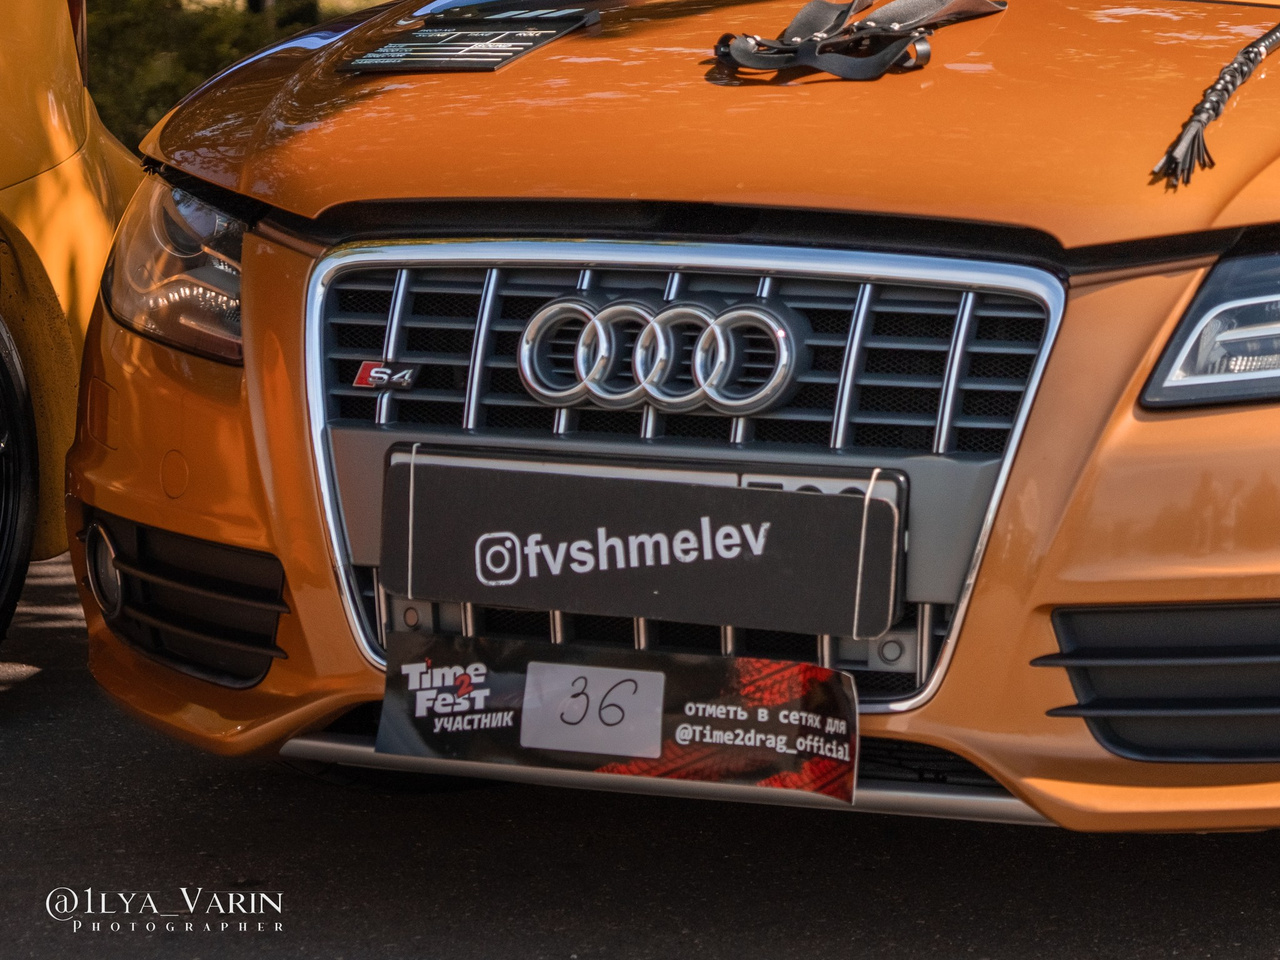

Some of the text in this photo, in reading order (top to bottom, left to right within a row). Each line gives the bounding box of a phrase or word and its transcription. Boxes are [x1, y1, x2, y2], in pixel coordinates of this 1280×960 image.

[368, 367, 414, 386] S4
[523, 516, 771, 577] fvshmelev
[401, 657, 487, 690] Time
[415, 688, 490, 717] Fest
[560, 676, 638, 726] 36
[684, 701, 847, 734] отметь в сетях для
[433, 711, 514, 733] УЧАСТНИК
[675, 724, 851, 761] @Time2drag_official
